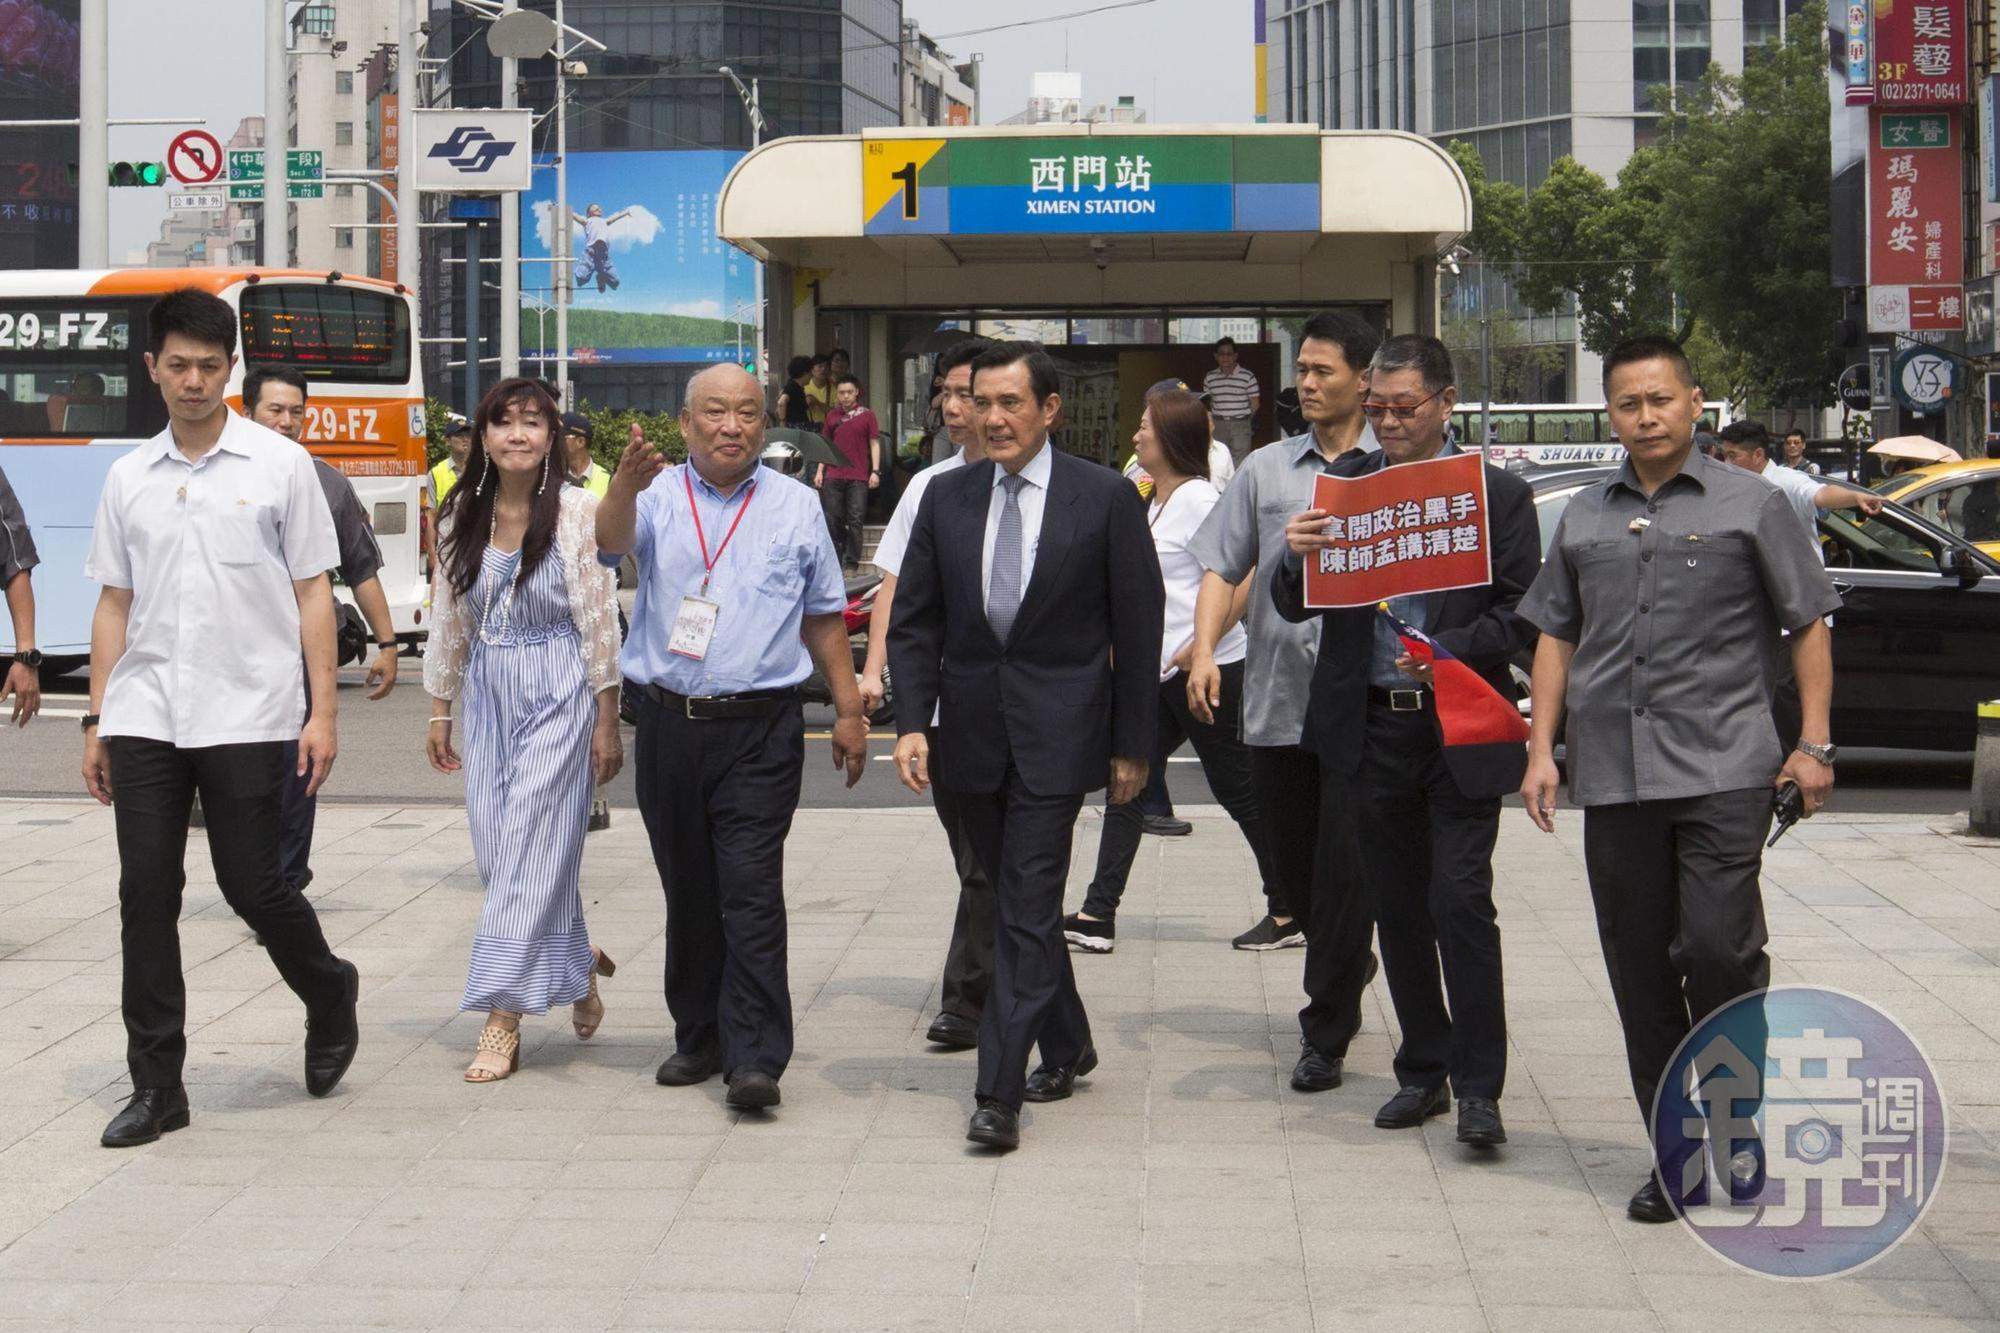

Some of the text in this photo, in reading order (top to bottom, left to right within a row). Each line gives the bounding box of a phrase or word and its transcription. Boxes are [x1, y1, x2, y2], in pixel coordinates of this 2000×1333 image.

[1912, 0, 1952, 76] 髮藝
[1878, 62, 1909, 81] 3F
[1888, 119, 1944, 143] 女醫
[892, 162, 917, 218] 1
[1029, 155, 1152, 193] 西門站
[1027, 199, 1156, 214] XIMEN STATION
[1886, 154, 1919, 252] 瑪麗安
[1924, 221, 1942, 280] 婦產科
[1912, 296, 1961, 320] 二樓
[299, 406, 380, 441] 29-FZ
[1540, 448, 1629, 461] SHUANG TI
[1319, 524, 1480, 574] 陳師孟講清楚
